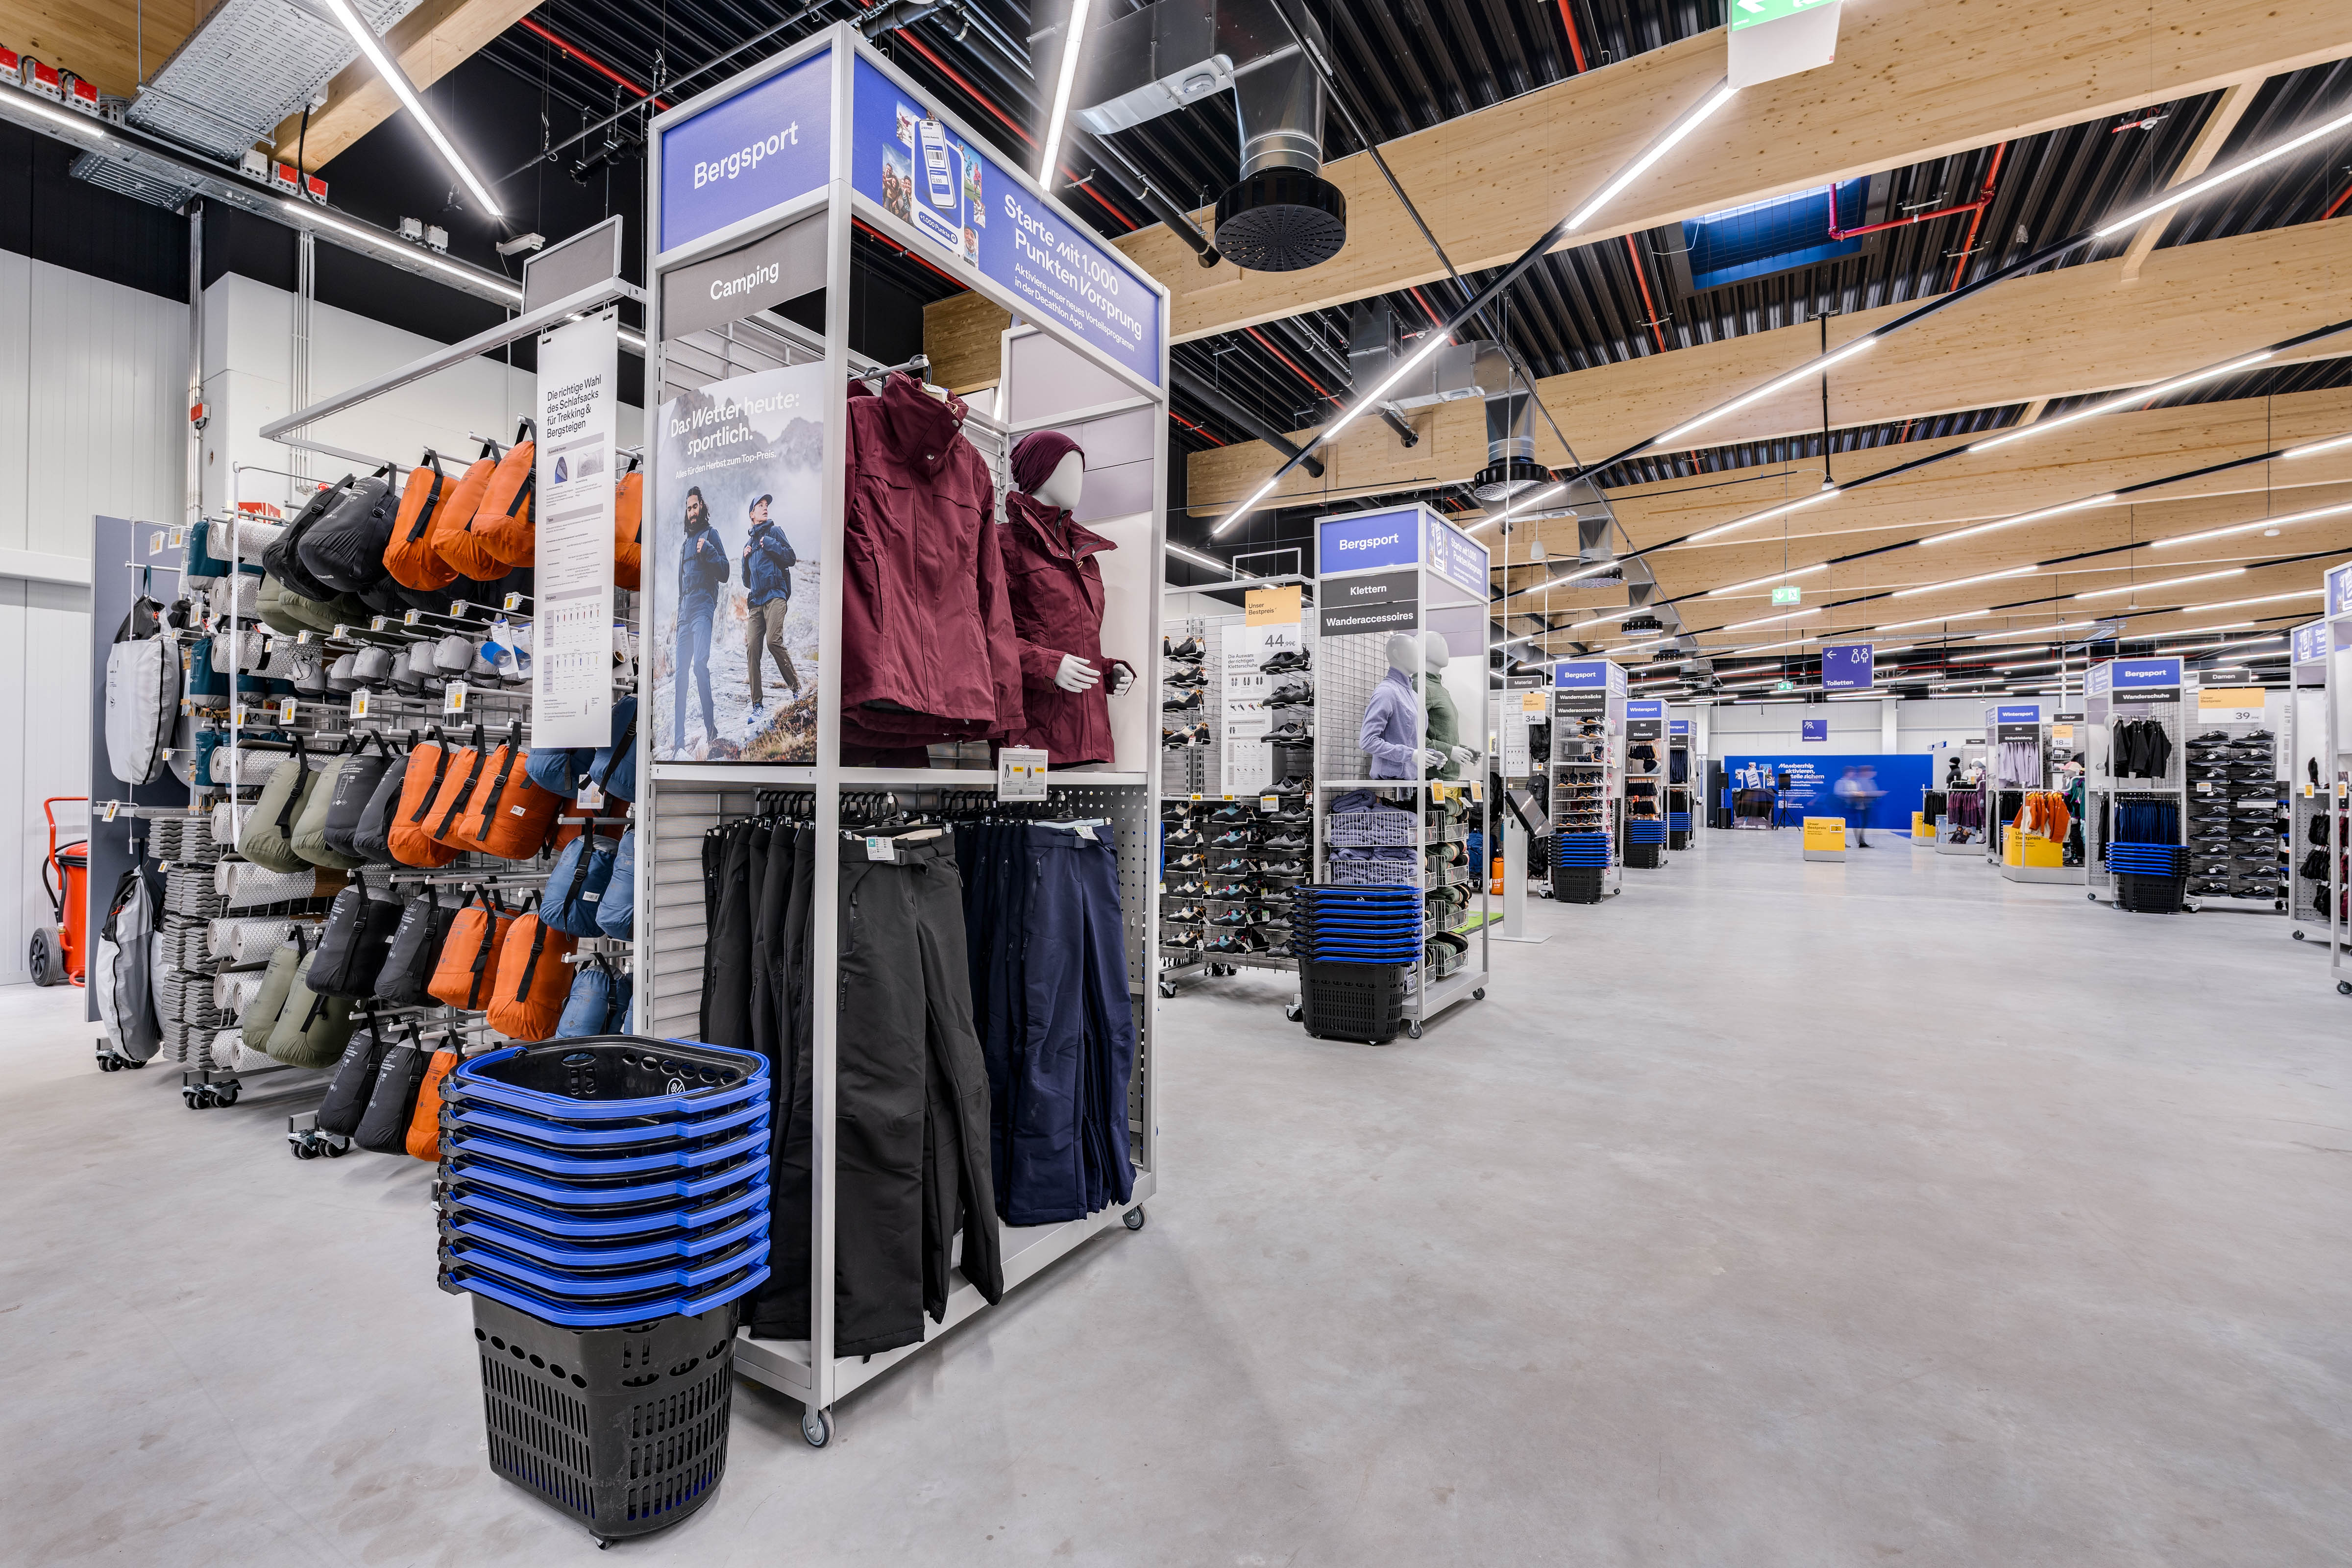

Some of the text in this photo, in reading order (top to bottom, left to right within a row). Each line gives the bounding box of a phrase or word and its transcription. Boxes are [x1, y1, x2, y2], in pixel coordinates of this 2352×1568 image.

[694, 121, 798, 189] Bergsport
[935, 224, 950, 238] Punkte
[1004, 194, 1118, 295] Starte mit 1.000
[710, 263, 780, 300] Camping
[1015, 228, 1142, 342] Punkten Vorsprung
[1015, 276, 1084, 330] in der Decathlon App.
[1015, 262, 1135, 352] Aktiviere unser neues Vorteilsprogramm
[547, 374, 601, 401] Die richtige Wahl
[547, 390, 599, 414] des Schlafsacks
[547, 403, 591, 426] für Trekking &
[671, 392, 800, 438] Das Wetter heute:
[547, 420, 586, 439] Bergsteigen
[687, 422, 753, 458] sportlich.
[675, 450, 777, 480] Alles für den Herbst zum Top-Preis.
[1339, 533, 1399, 551] Bergsport
[1350, 585, 1387, 595] Klettern
[1326, 612, 1414, 627] Wanderaccessoires
[1265, 634, 1296, 647] 44,99€
